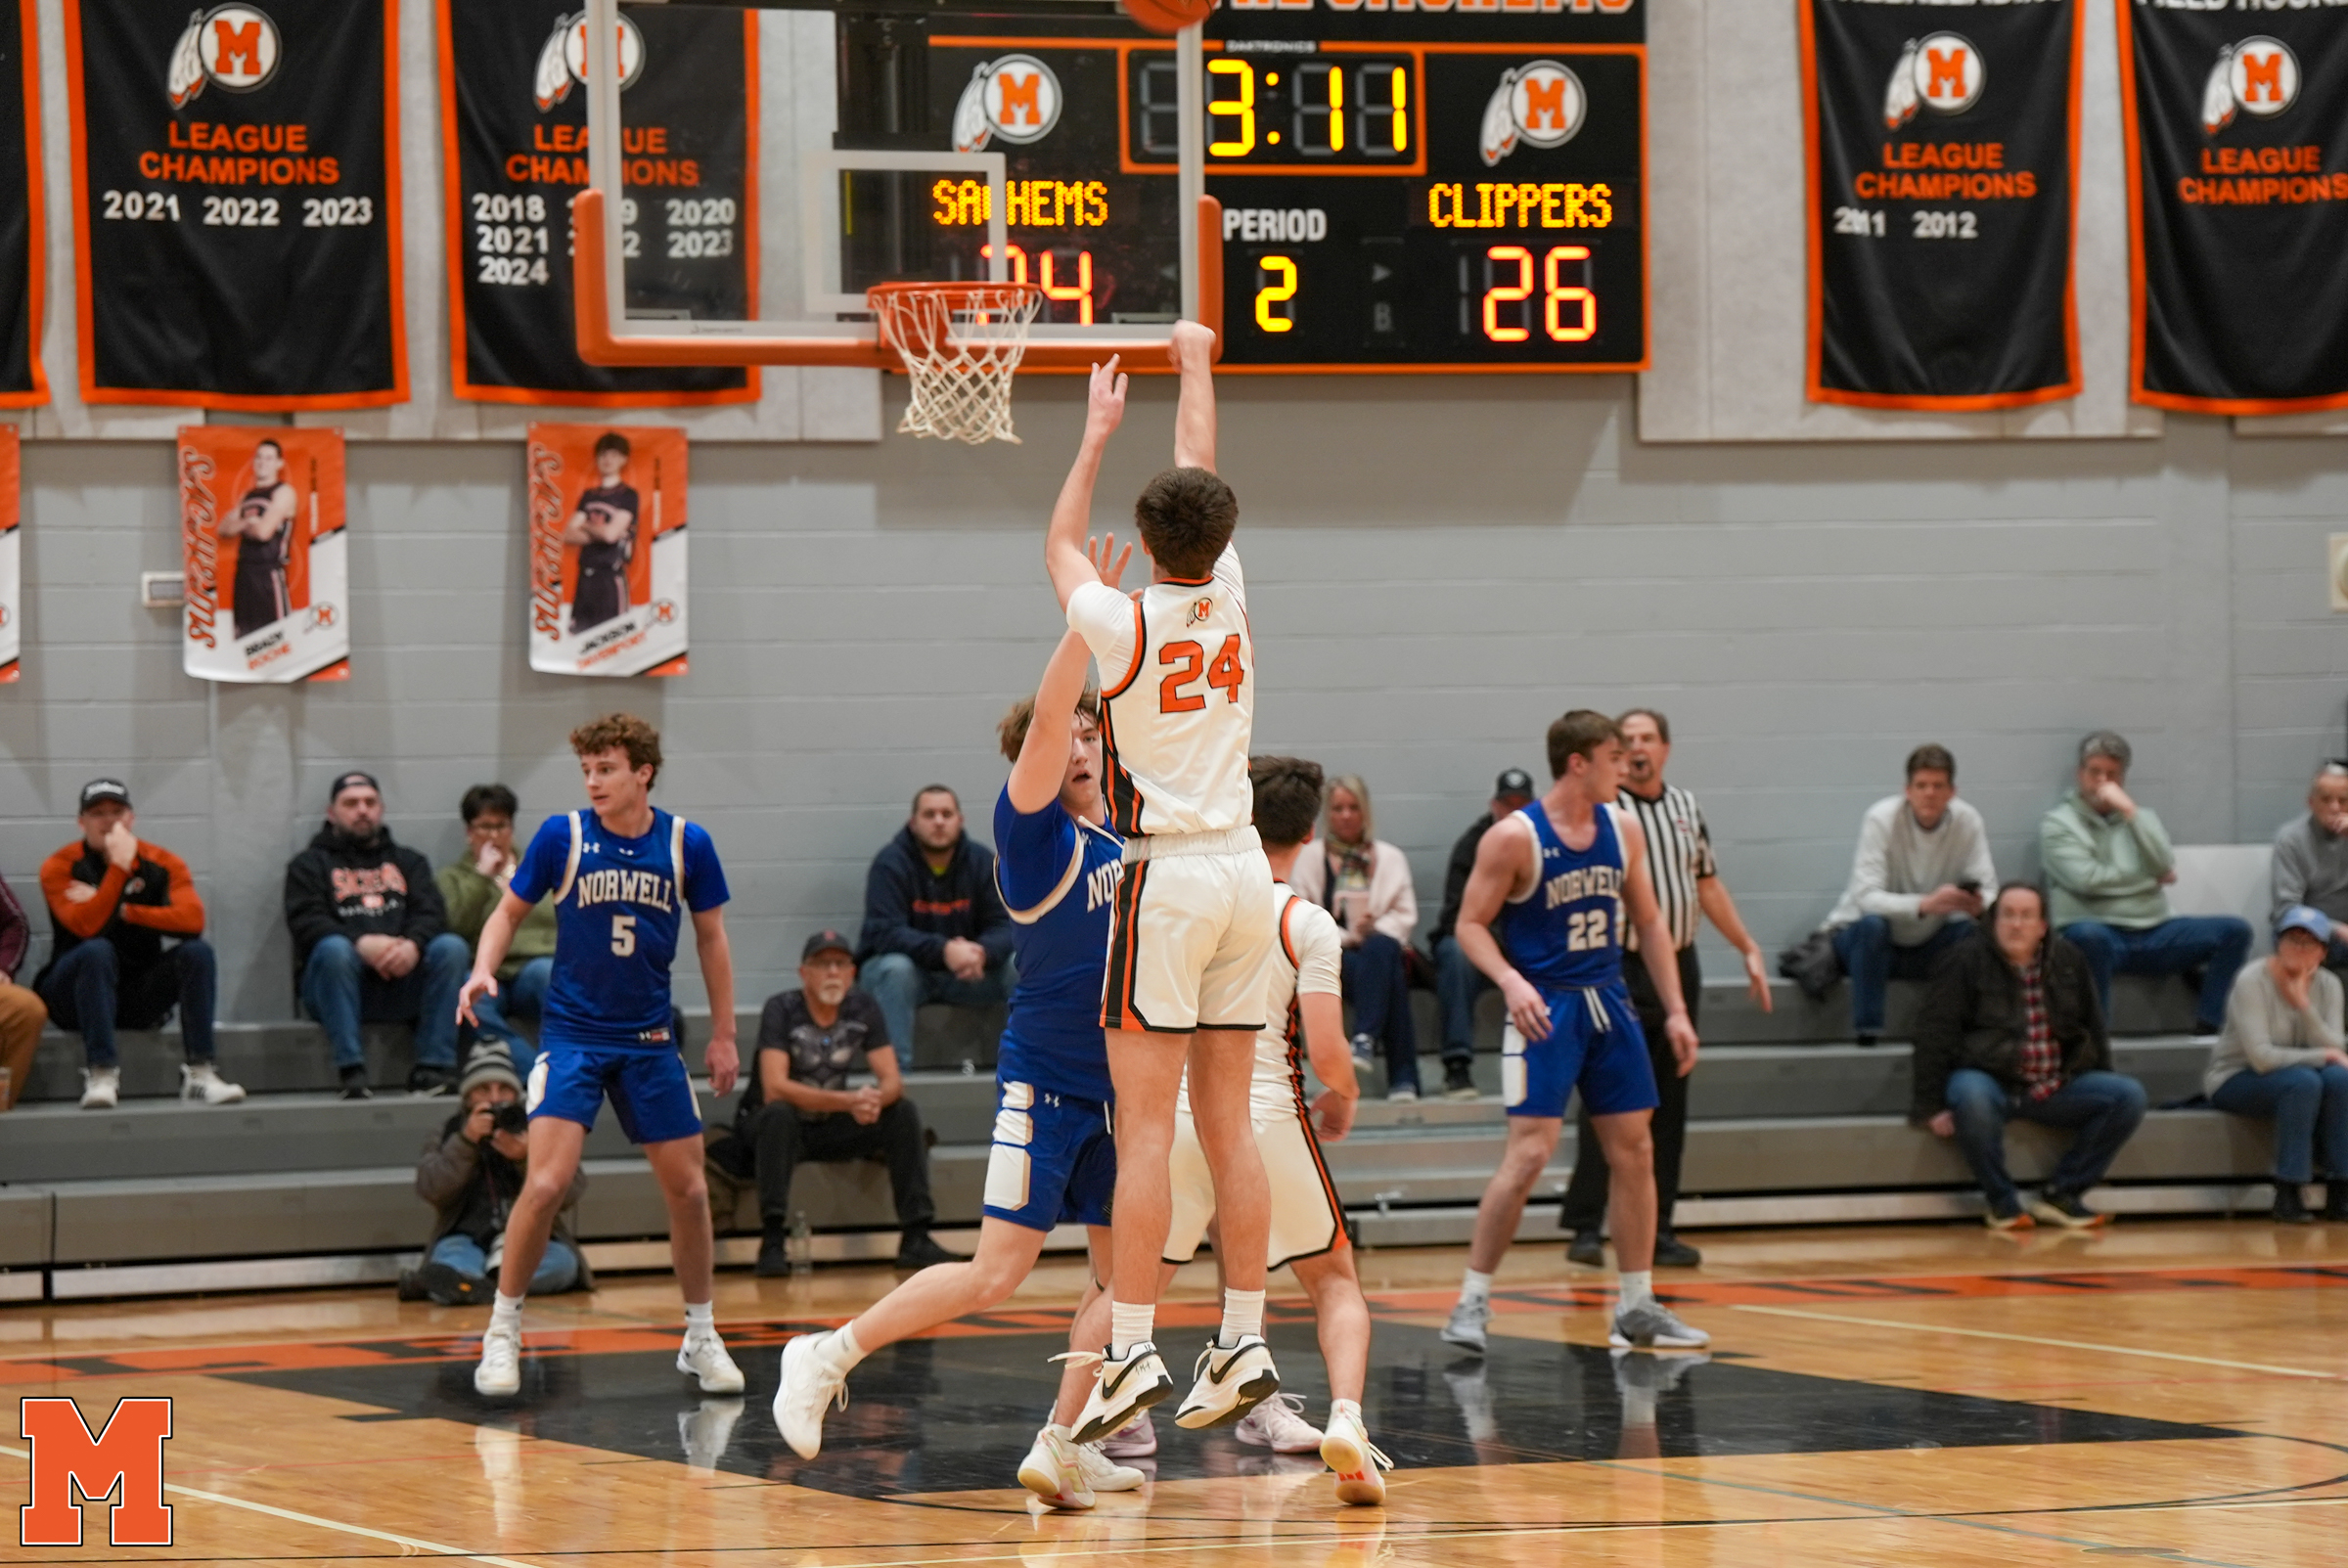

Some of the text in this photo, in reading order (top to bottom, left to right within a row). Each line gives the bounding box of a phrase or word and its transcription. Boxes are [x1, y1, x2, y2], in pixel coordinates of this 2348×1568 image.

[213, 20, 262, 75] M
[1927, 49, 1966, 98] M
[2241, 53, 2284, 103] M
[998, 73, 1041, 125] M
[1206, 59, 1407, 157] 3:11
[1524, 78, 1566, 130] M
[168, 120, 308, 153] LEAGUE
[534, 125, 668, 155] LEAUE
[139, 152, 340, 185] CHAMPIONS
[505, 155, 700, 187] CHAMIONS
[1882, 143, 2004, 168] LEAGUE
[2201, 146, 2322, 174] LEAGUE
[1855, 171, 2037, 200] CHAMPIONS
[2178, 172, 2348, 204] CHAMPIONS
[103, 191, 374, 227] 2021 2022 2023
[472, 194, 546, 222] 2018
[665, 198, 737, 227] 2020
[1428, 183, 1612, 228] CLIPPERS
[476, 226, 550, 254] 2021
[667, 228, 734, 258] 2023
[1223, 208, 1327, 242] PERIOD
[1912, 209, 1978, 240] 2012
[477, 257, 550, 285] 2024
[1255, 255, 1297, 333] 2
[1482, 246, 1597, 341] 26
[1197, 601, 1211, 618] M
[1158, 633, 1244, 713] 24
[577, 868, 673, 914] NORWELL
[610, 915, 637, 957] 5
[1567, 909, 1608, 952] 22
